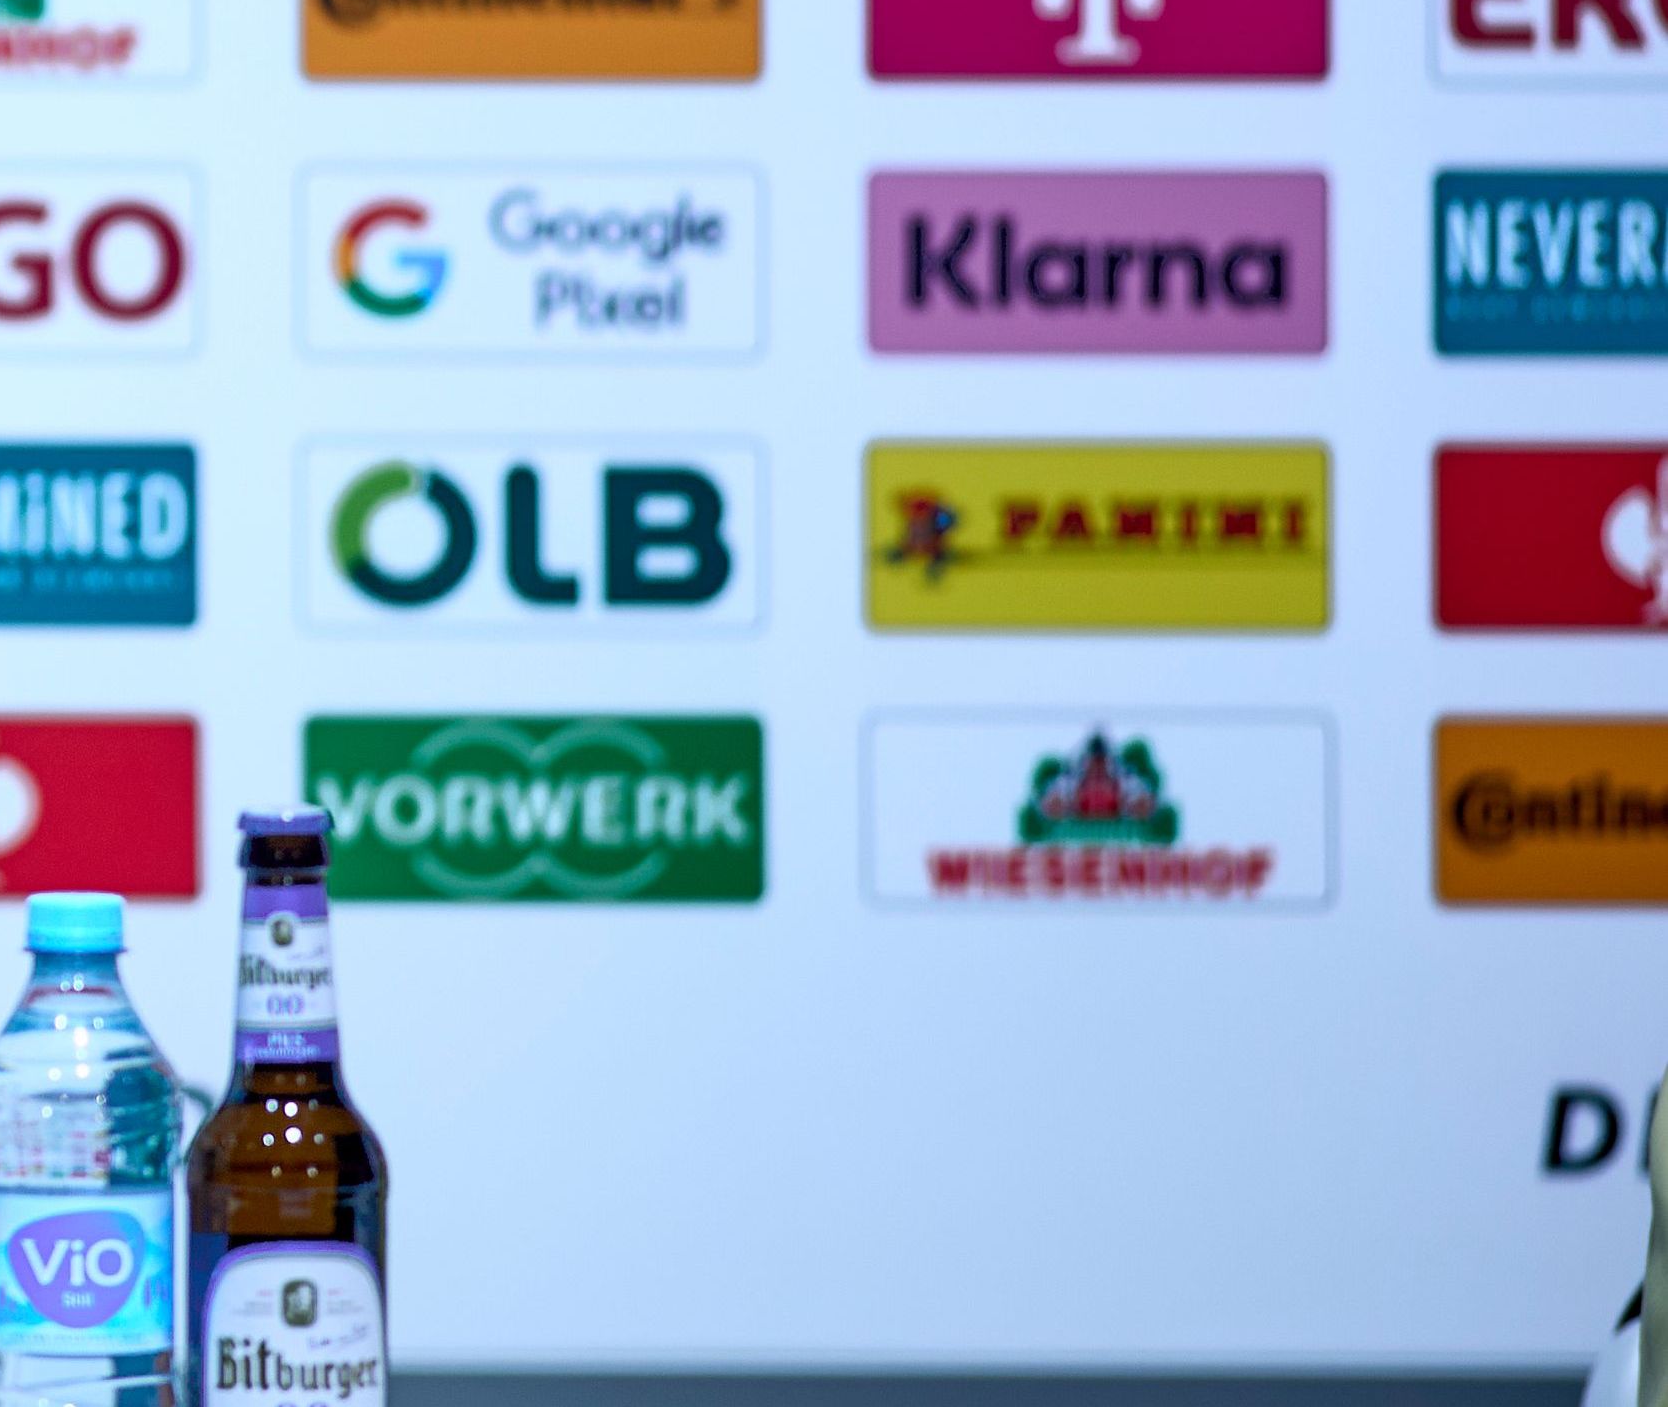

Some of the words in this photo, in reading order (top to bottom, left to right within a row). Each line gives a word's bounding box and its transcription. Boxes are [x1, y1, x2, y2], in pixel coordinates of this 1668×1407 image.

[486, 184, 727, 268] Google
[902, 210, 1291, 312] Klarna
[1443, 196, 1668, 290] NEVER
[534, 270, 687, 330] Pixel
[328, 458, 733, 609] OLB
[1000, 497, 1308, 547] PANINI
[314, 772, 750, 847] VORWERK
[926, 845, 1276, 897] WIESENHOF
[216, 1335, 379, 1400] Bitburger
